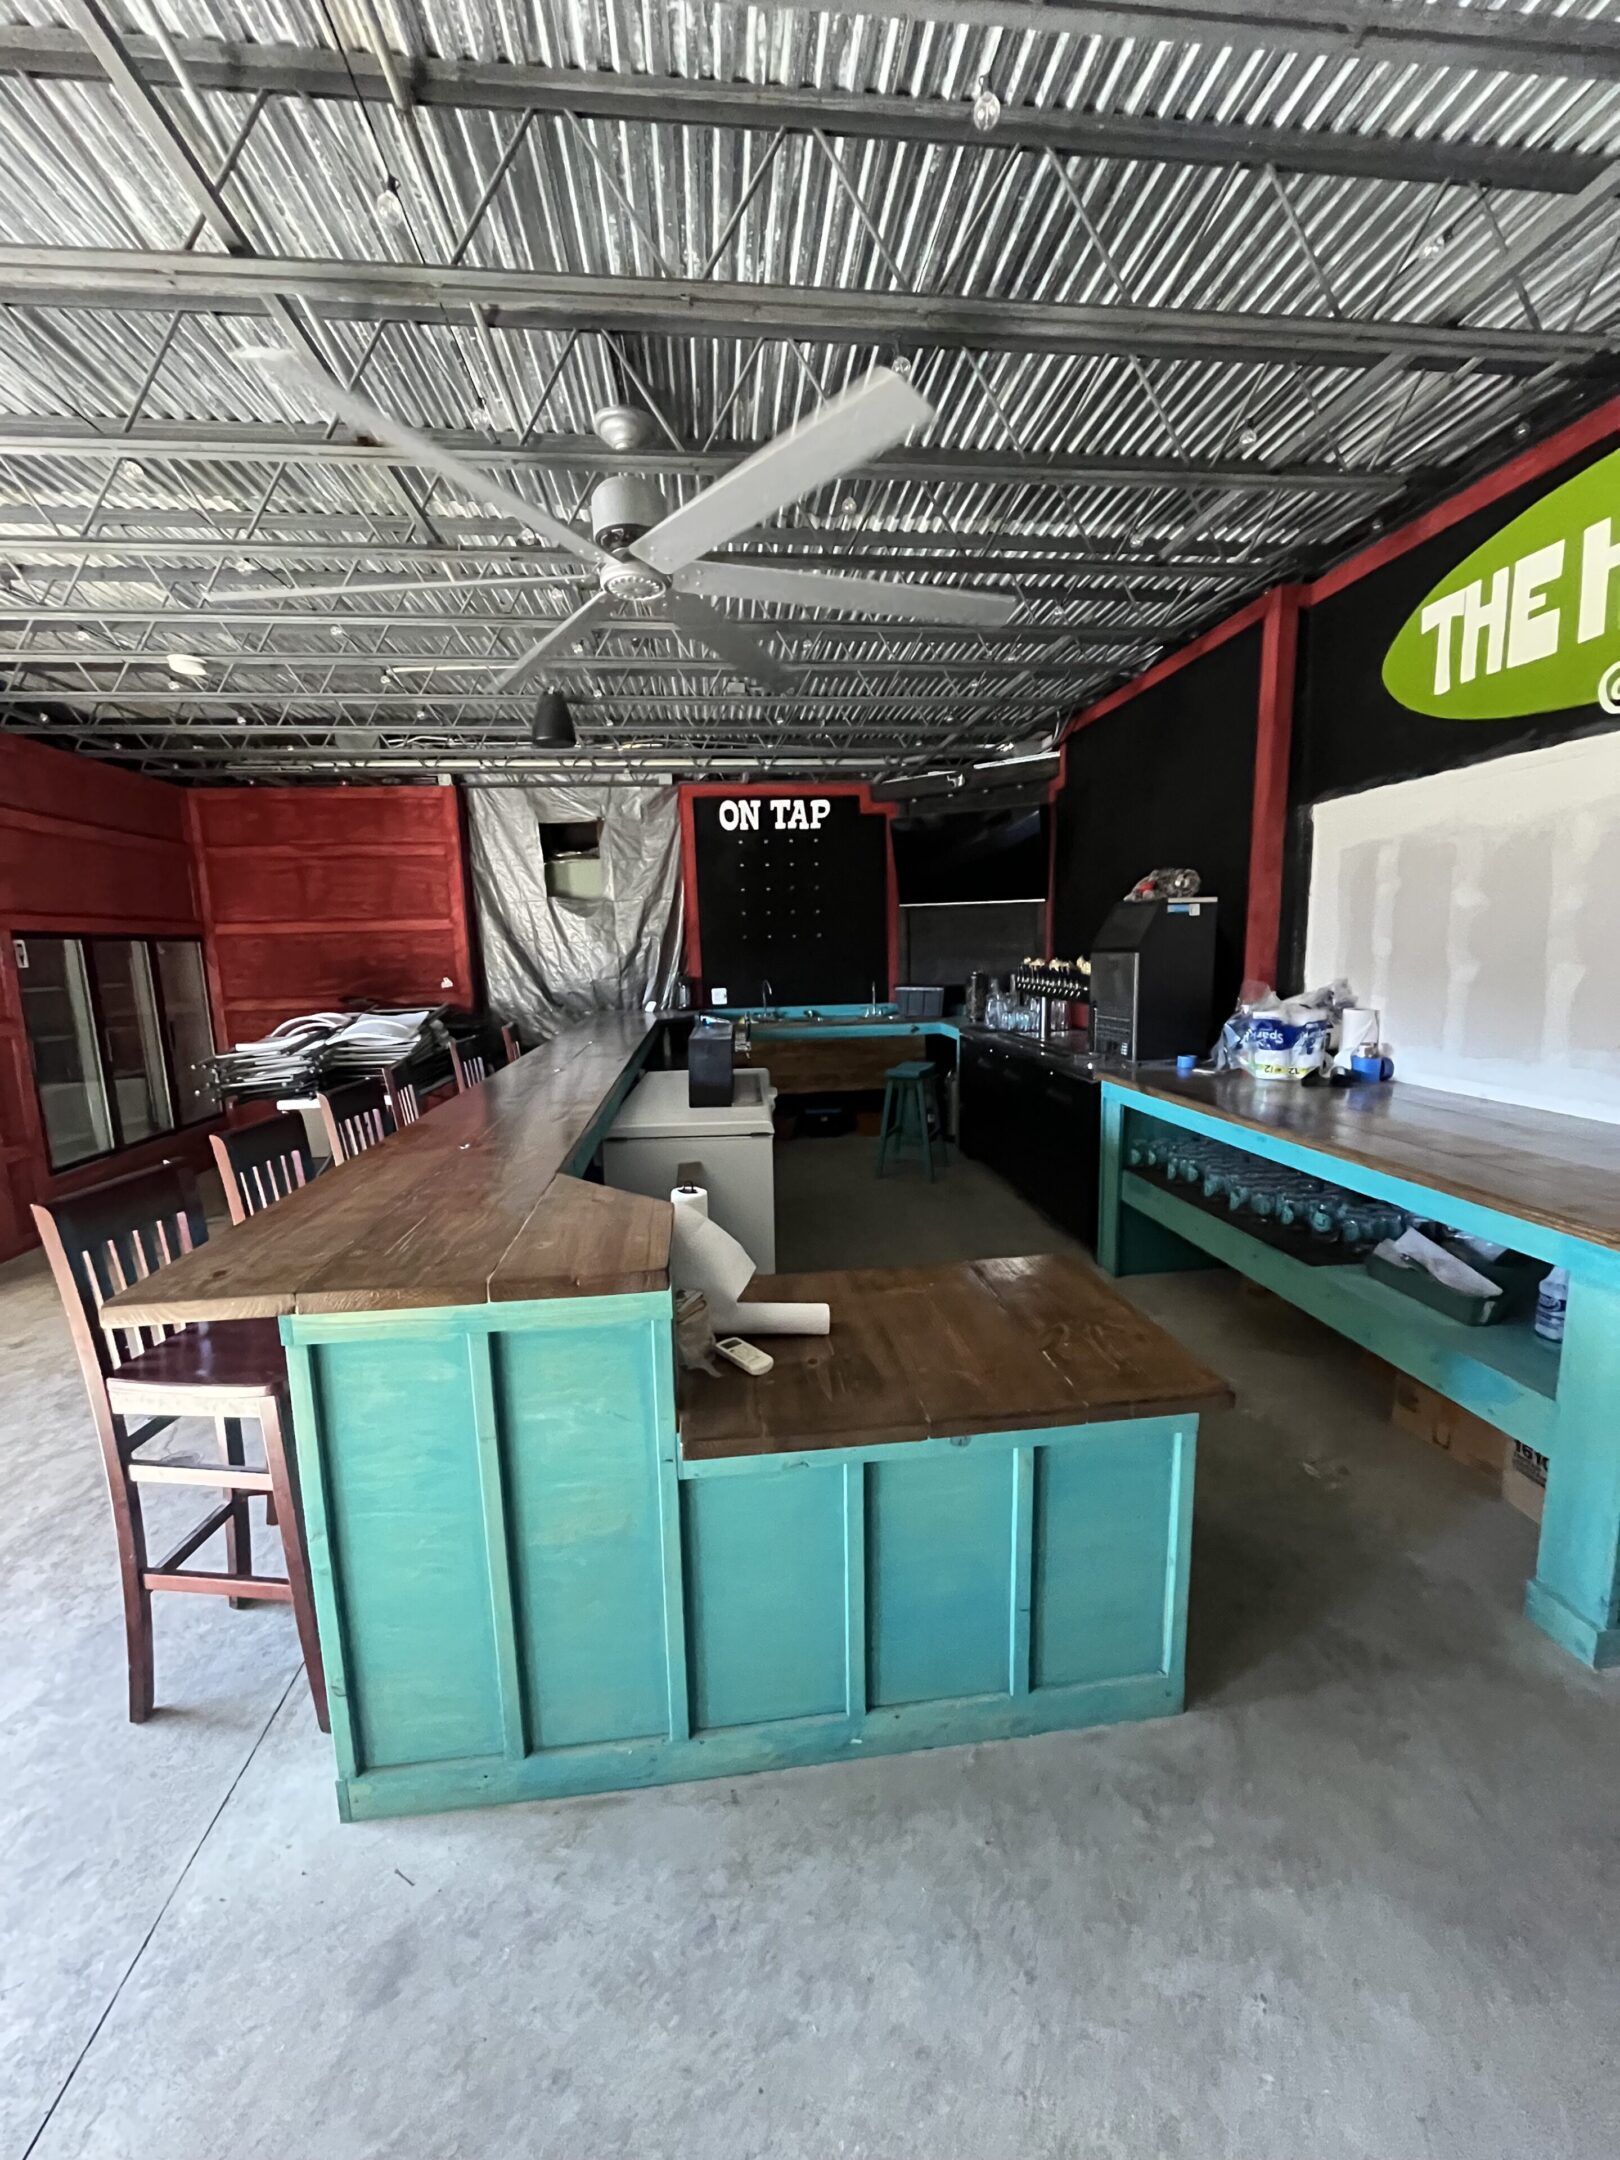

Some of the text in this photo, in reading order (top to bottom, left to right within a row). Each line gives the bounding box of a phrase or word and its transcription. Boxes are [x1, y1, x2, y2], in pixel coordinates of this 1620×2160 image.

[1421, 539, 1565, 696] THE
[719, 799, 831, 831] ON TAP
